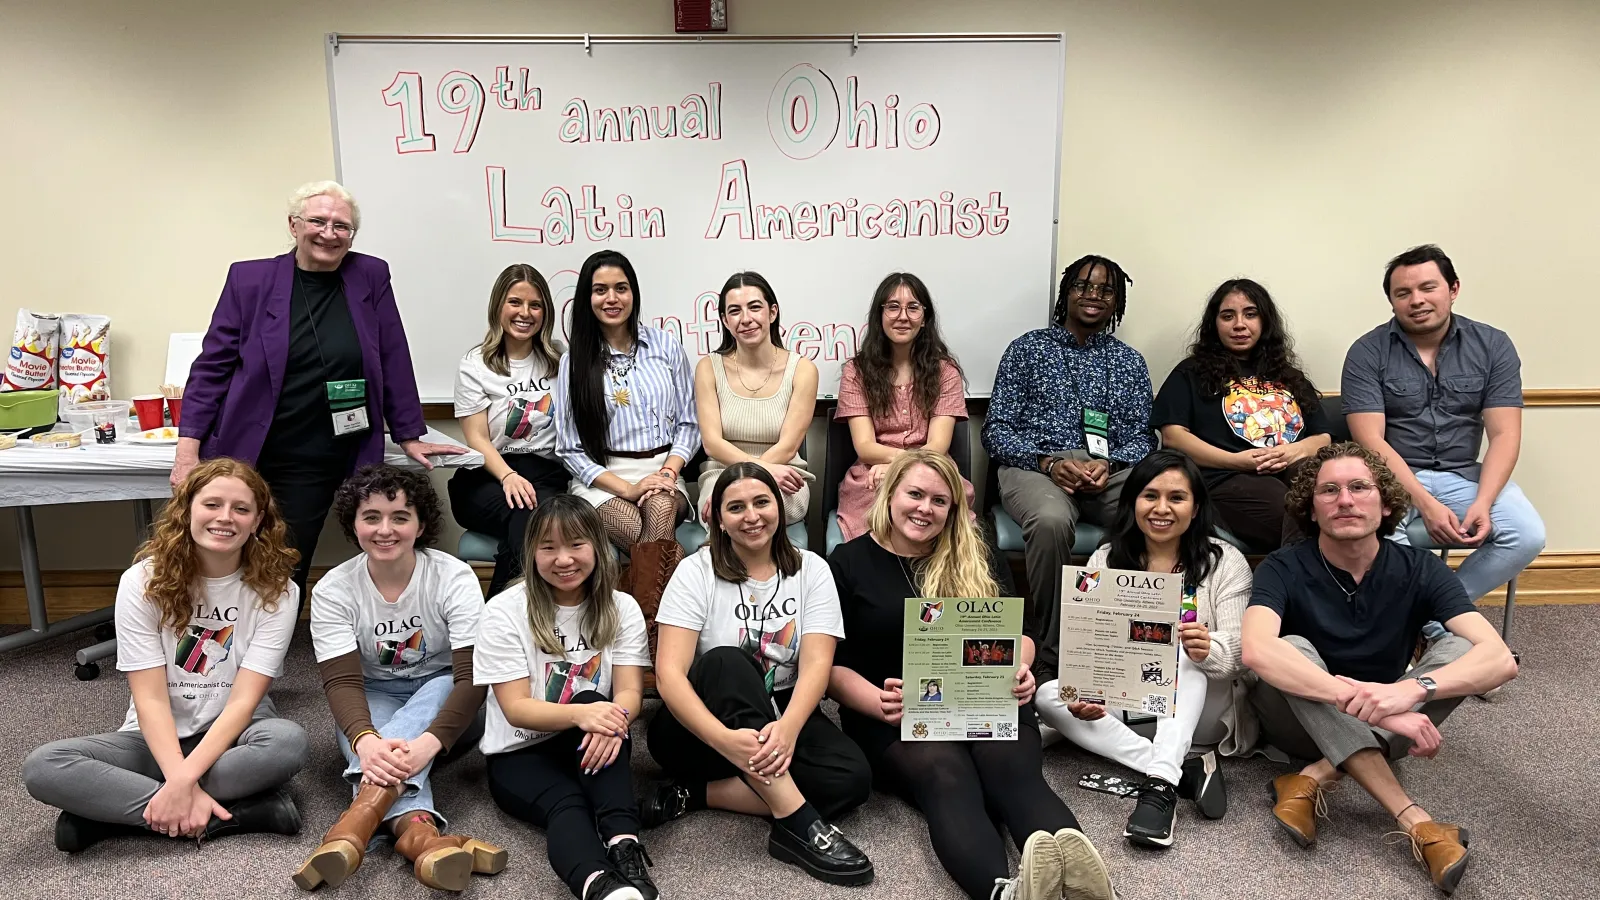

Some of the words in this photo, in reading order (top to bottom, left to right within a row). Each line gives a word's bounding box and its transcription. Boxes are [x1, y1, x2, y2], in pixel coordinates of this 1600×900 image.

[381, 66, 542, 154] 19th
[560, 82, 722, 143] annual
[767, 63, 941, 160] Ohio
[486, 166, 666, 246] Latin
[704, 159, 1010, 241] Americanist
[20, 360, 47, 371] Movie
[71, 357, 96, 365] Movie
[507, 377, 551, 396] OLAC
[1116, 575, 1165, 590] OLAC
[195, 604, 239, 622] LAC
[734, 598, 797, 621] OLAC
[956, 600, 1004, 613] OLAC
[374, 616, 422, 636] OLAC
[179, 681, 219, 689] Americanist
